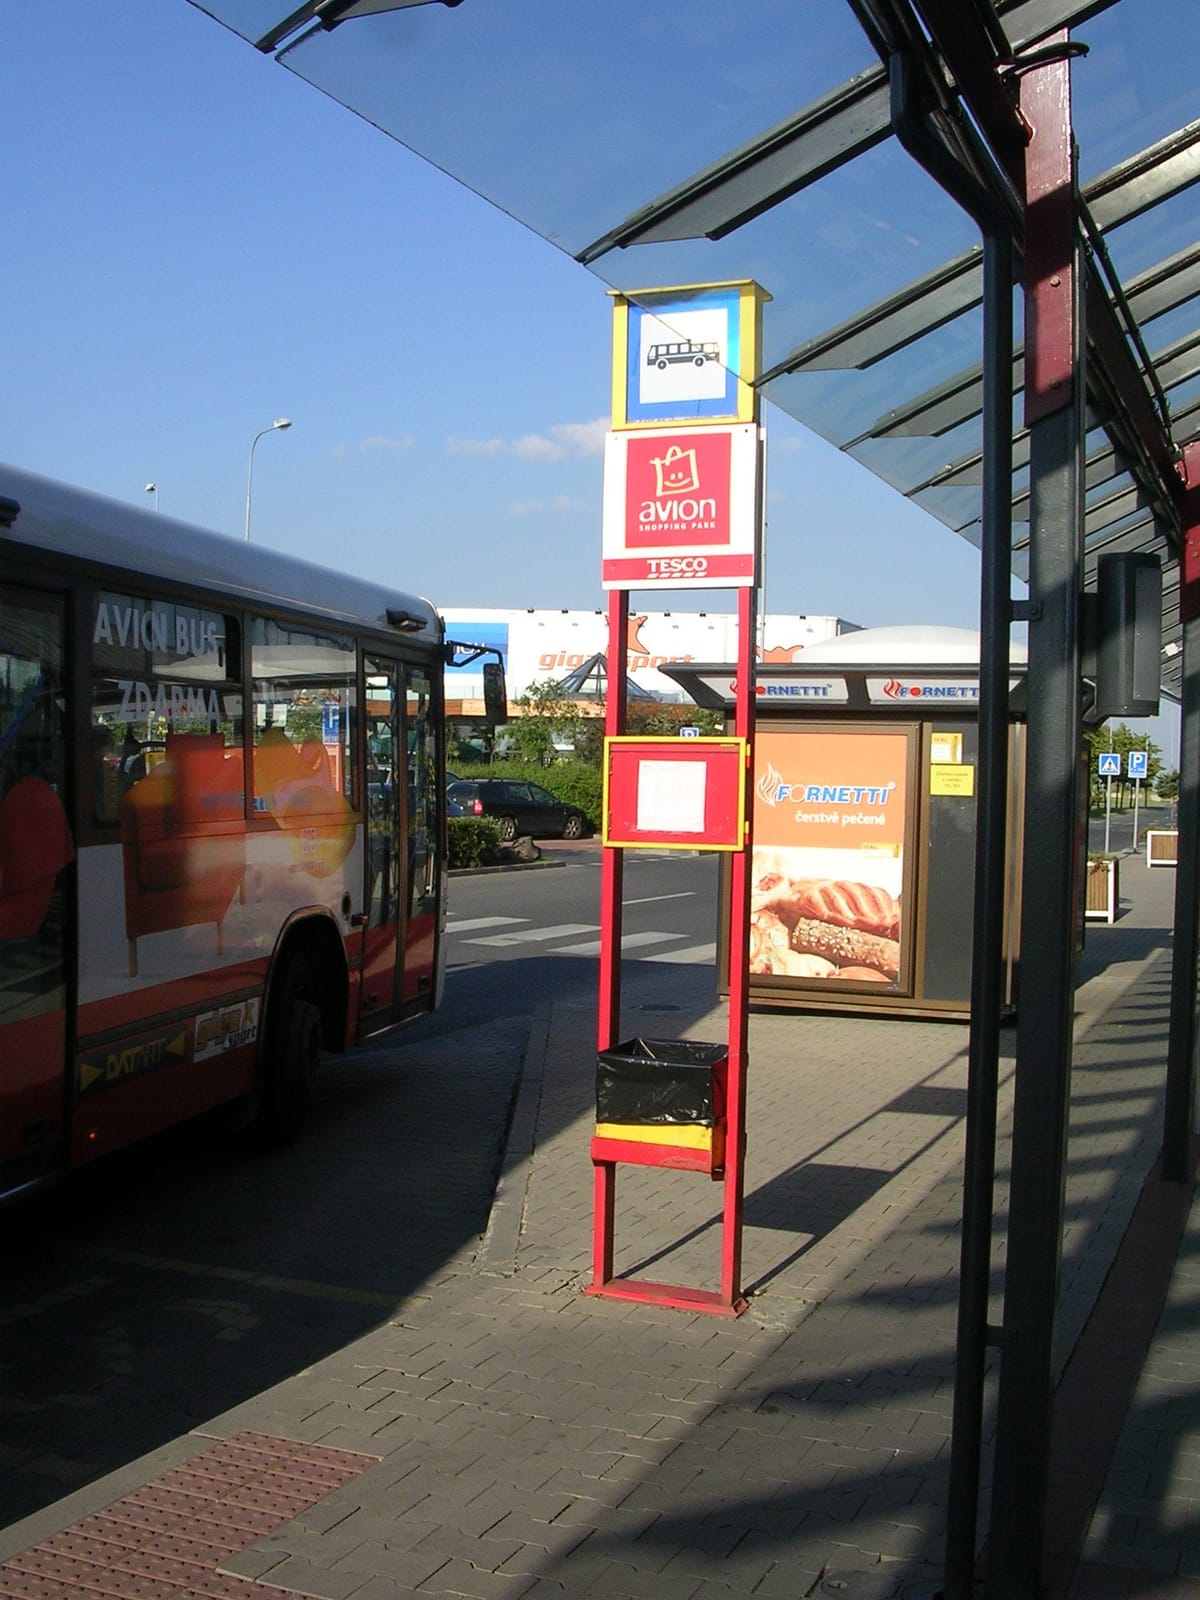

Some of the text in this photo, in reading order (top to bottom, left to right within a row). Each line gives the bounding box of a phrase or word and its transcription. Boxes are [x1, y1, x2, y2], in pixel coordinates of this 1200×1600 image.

[639, 498, 717, 523] avion
[638, 521, 717, 532] SHOPPING PARK
[647, 556, 708, 574] TESCO
[176, 616, 219, 658] BUS
[117, 679, 221, 732] ZDARMA
[776, 784, 889, 804] FORNETTI
